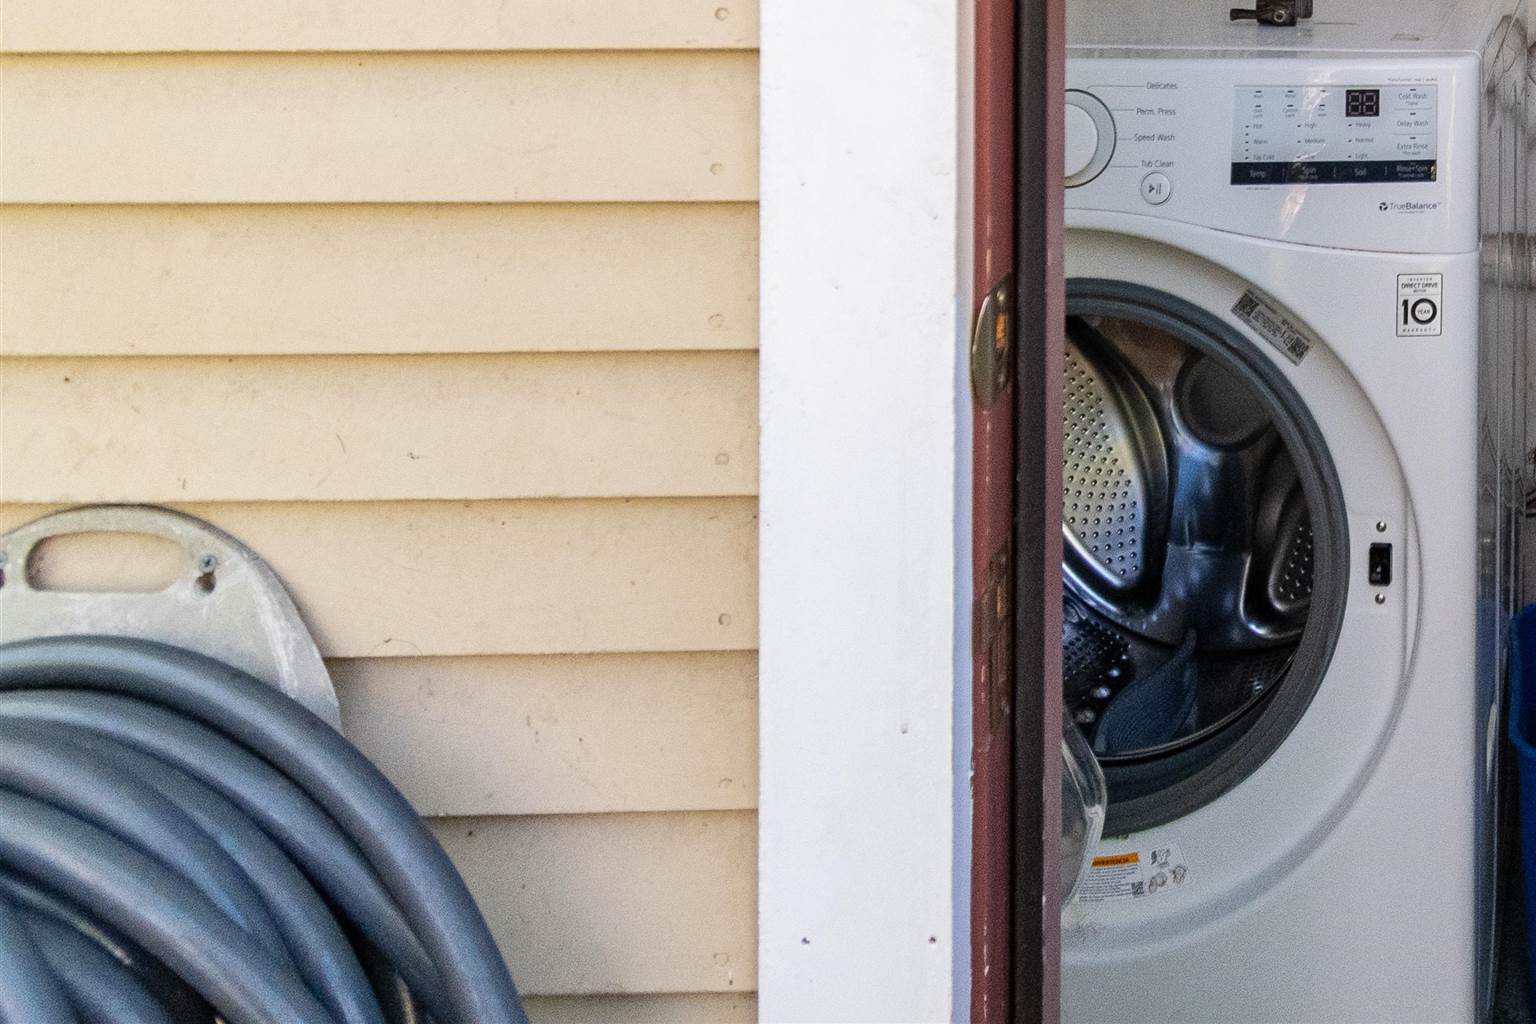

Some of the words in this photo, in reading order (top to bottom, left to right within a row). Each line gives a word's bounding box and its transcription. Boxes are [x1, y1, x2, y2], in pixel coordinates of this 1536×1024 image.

[1146, 81, 1178, 90] Delicates
[1157, 107, 1177, 116] Press
[1396, 120, 1413, 128] Delay
[1134, 133, 1156, 143] Speed
[1156, 133, 1176, 142] Wash
[1141, 160, 1154, 168] Tub
[1154, 160, 1175, 168] Clean
[1401, 297, 1438, 326] 10
